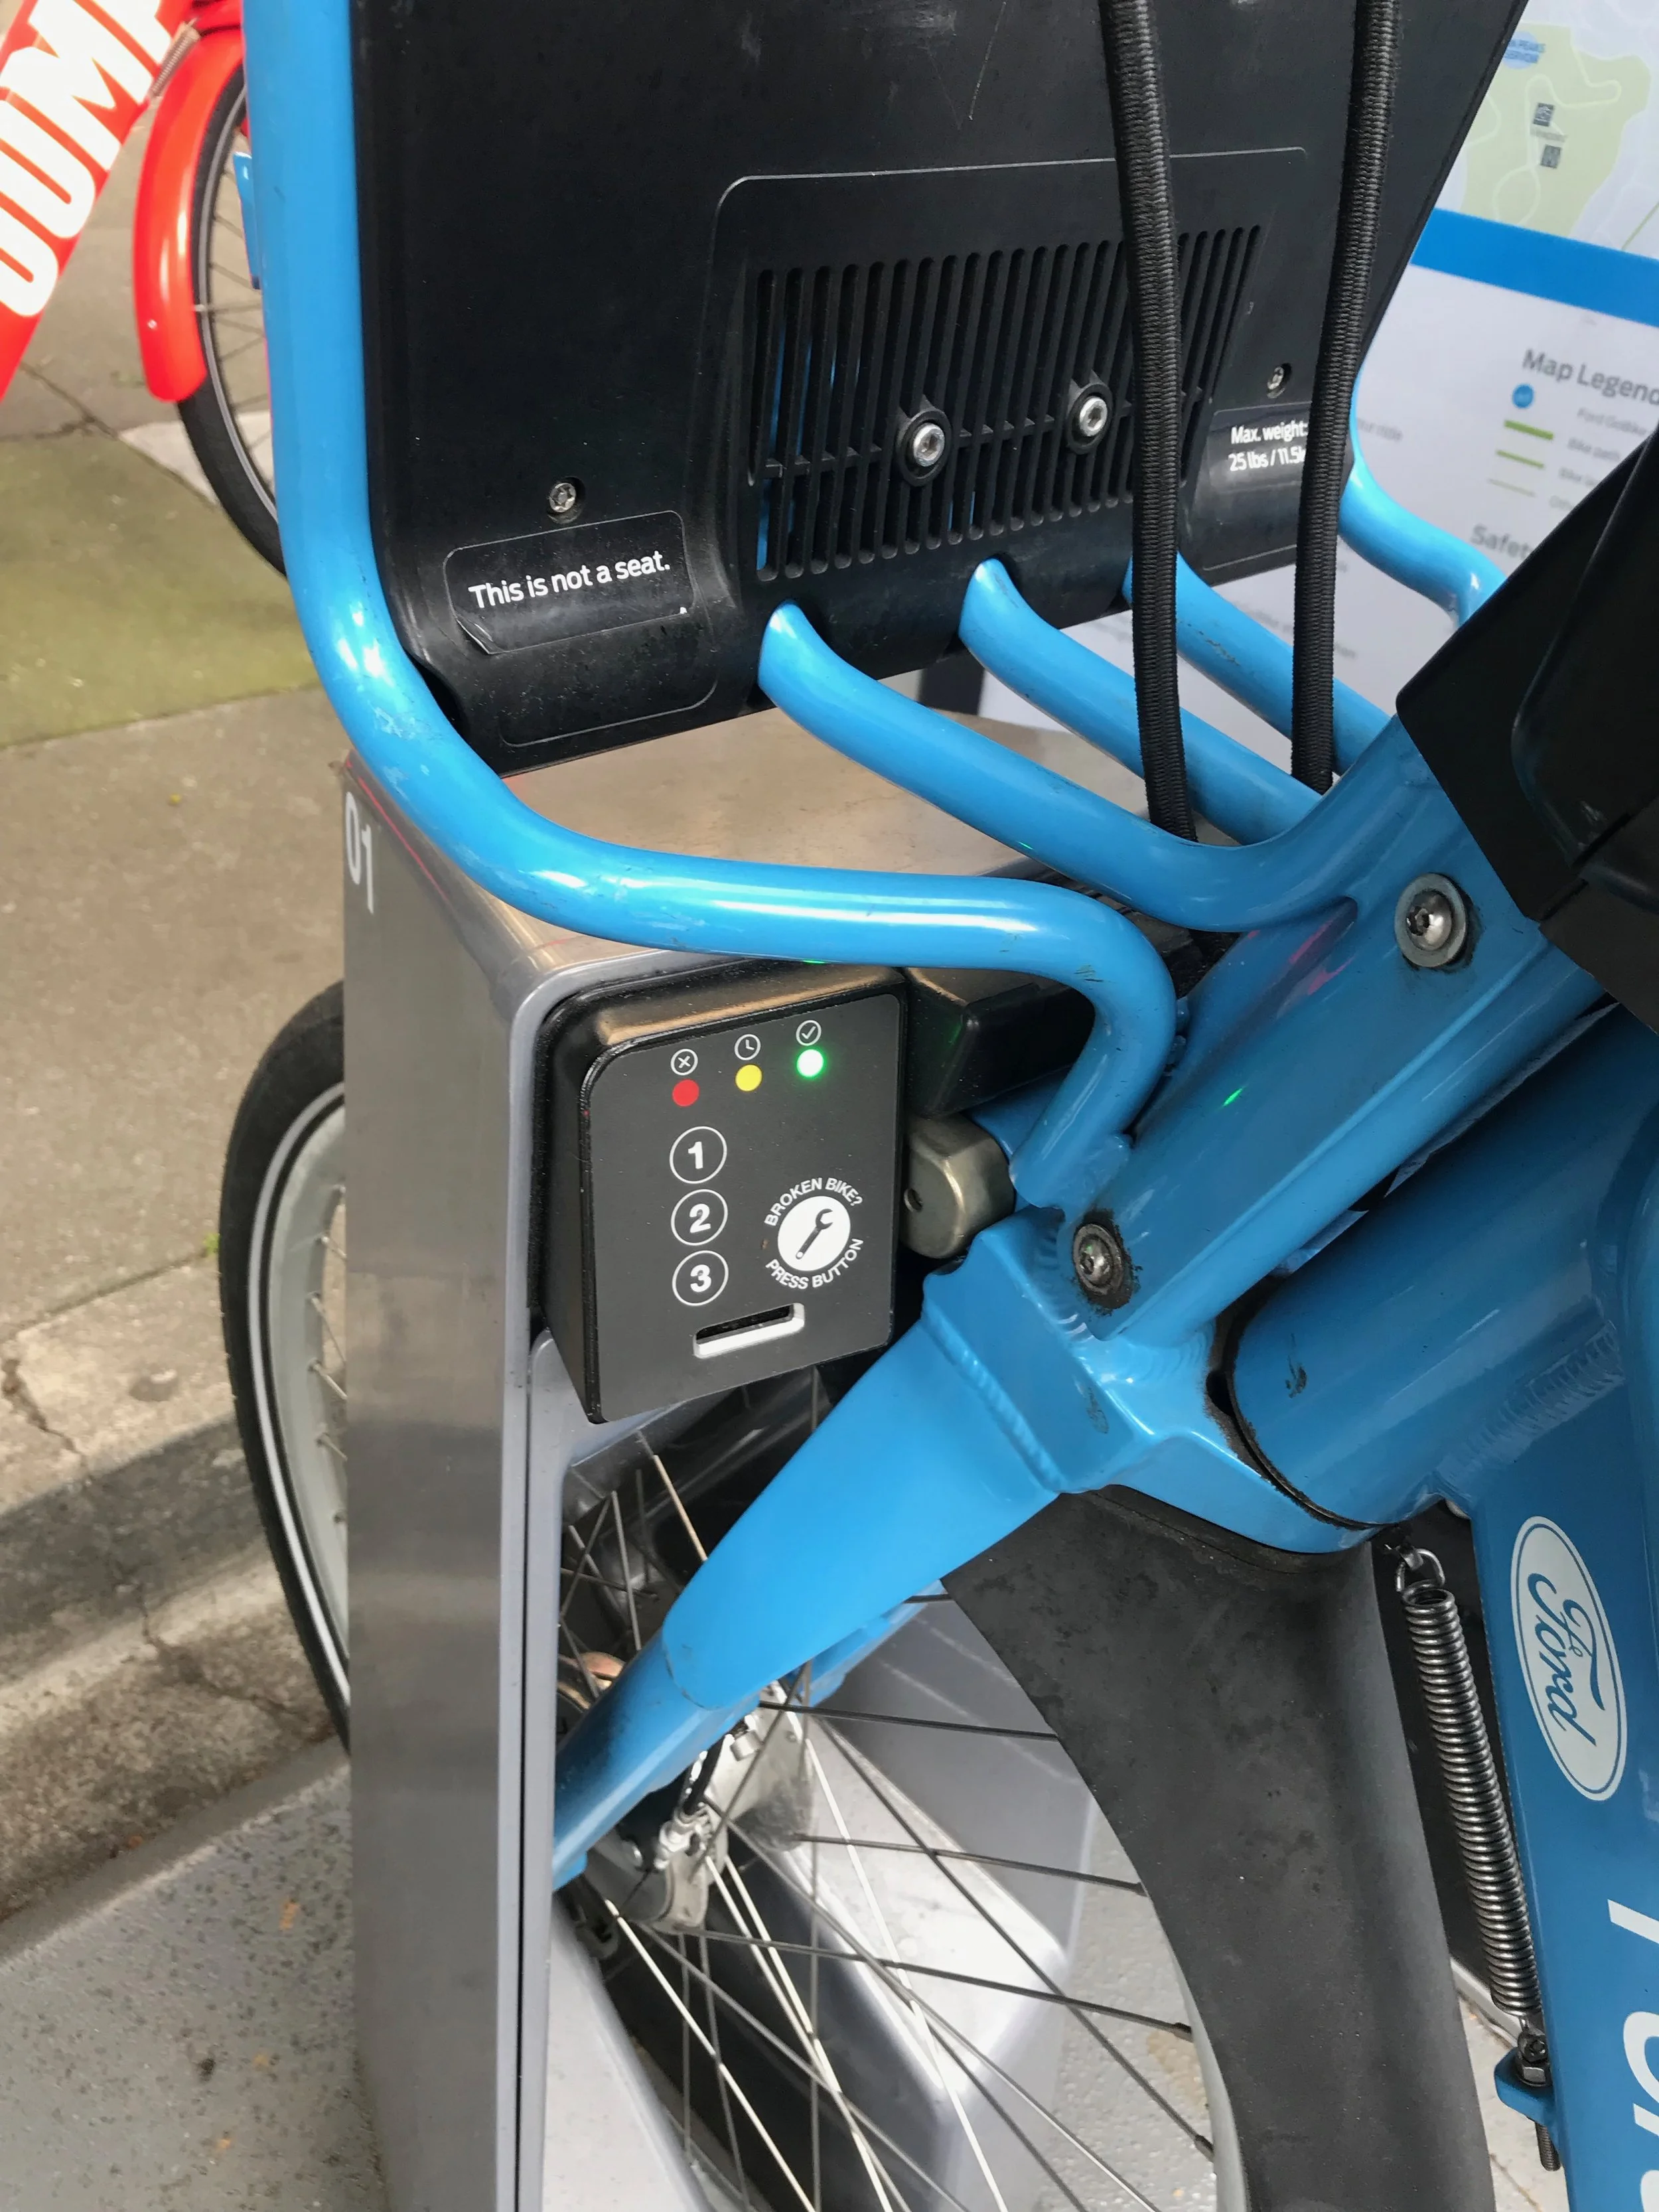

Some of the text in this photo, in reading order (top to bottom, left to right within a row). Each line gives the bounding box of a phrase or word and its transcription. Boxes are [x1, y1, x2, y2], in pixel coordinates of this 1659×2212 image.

[1522, 348, 1573, 383] Map
[1230, 419, 1309, 444] Max. weight:
[1228, 452, 1248, 471] 25
[1247, 451, 1268, 469] lbs
[1270, 449, 1275, 466] /
[1470, 523, 1532, 561] Safet
[469, 550, 670, 608] This is not a seat.
[345, 791, 374, 915] 01
[687, 1141, 704, 1169] 1
[689, 1203, 711, 1233] 2
[764, 1177, 863, 1226] BROKEN BIKE?
[690, 1264, 711, 1293] 3
[765, 1238, 864, 1290] PRESS BUTTON
[1527, 1572, 1606, 1747] Ford
